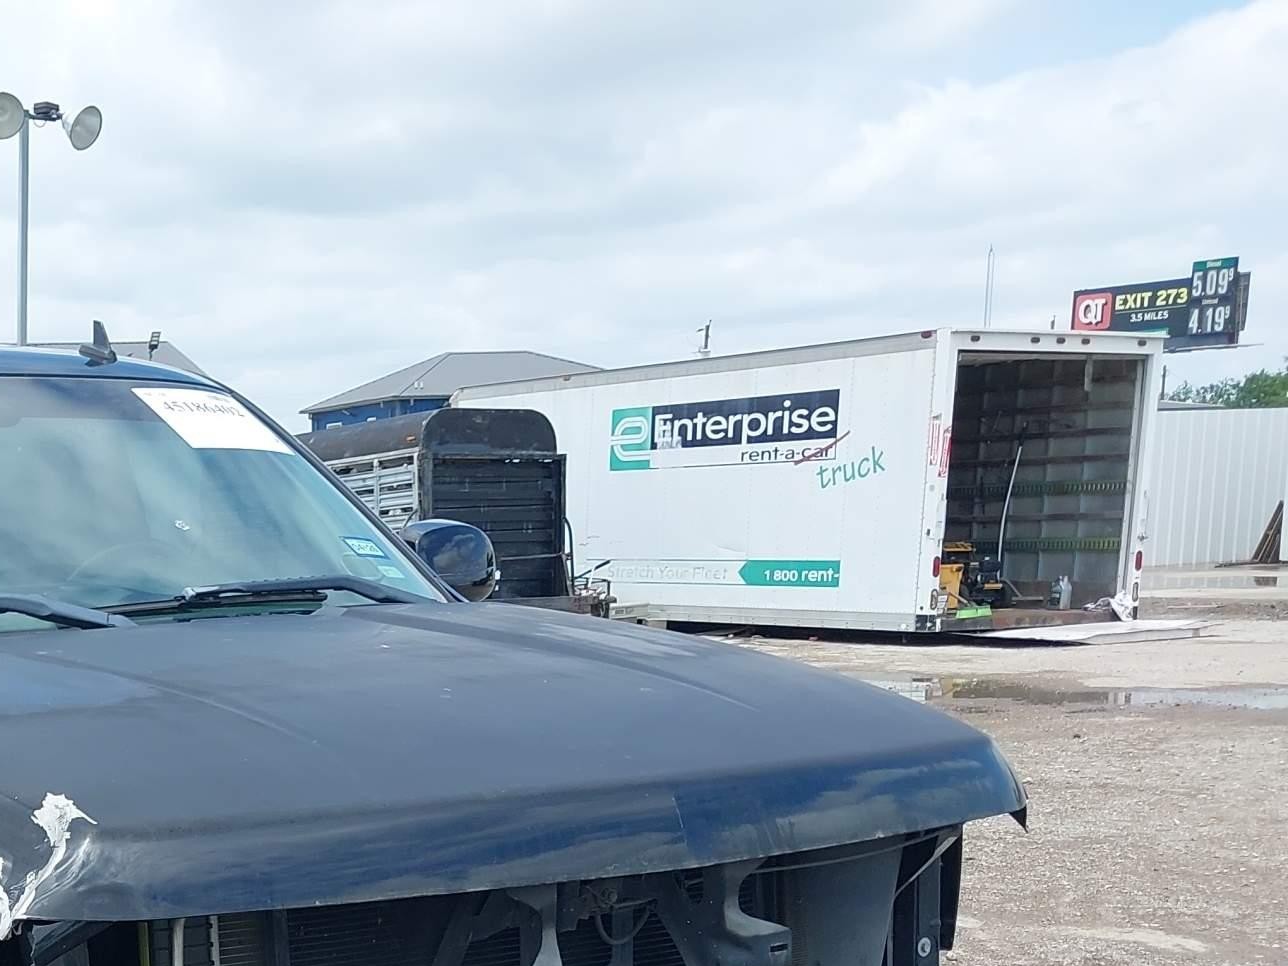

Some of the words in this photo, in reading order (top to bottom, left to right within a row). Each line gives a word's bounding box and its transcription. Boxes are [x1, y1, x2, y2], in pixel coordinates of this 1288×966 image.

[1115, 291, 1153, 310] EXIT
[1156, 287, 1188, 306] 273
[1078, 298, 1106, 326] QT
[1130, 312, 1142, 322] 3.5
[1144, 310, 1169, 321] MILES
[654, 400, 836, 445] Enterprise
[741, 446, 834, 463] rent-a-car
[816, 446, 886, 489] truck
[773, 569, 799, 581] 800
[801, 566, 839, 582] rent-
